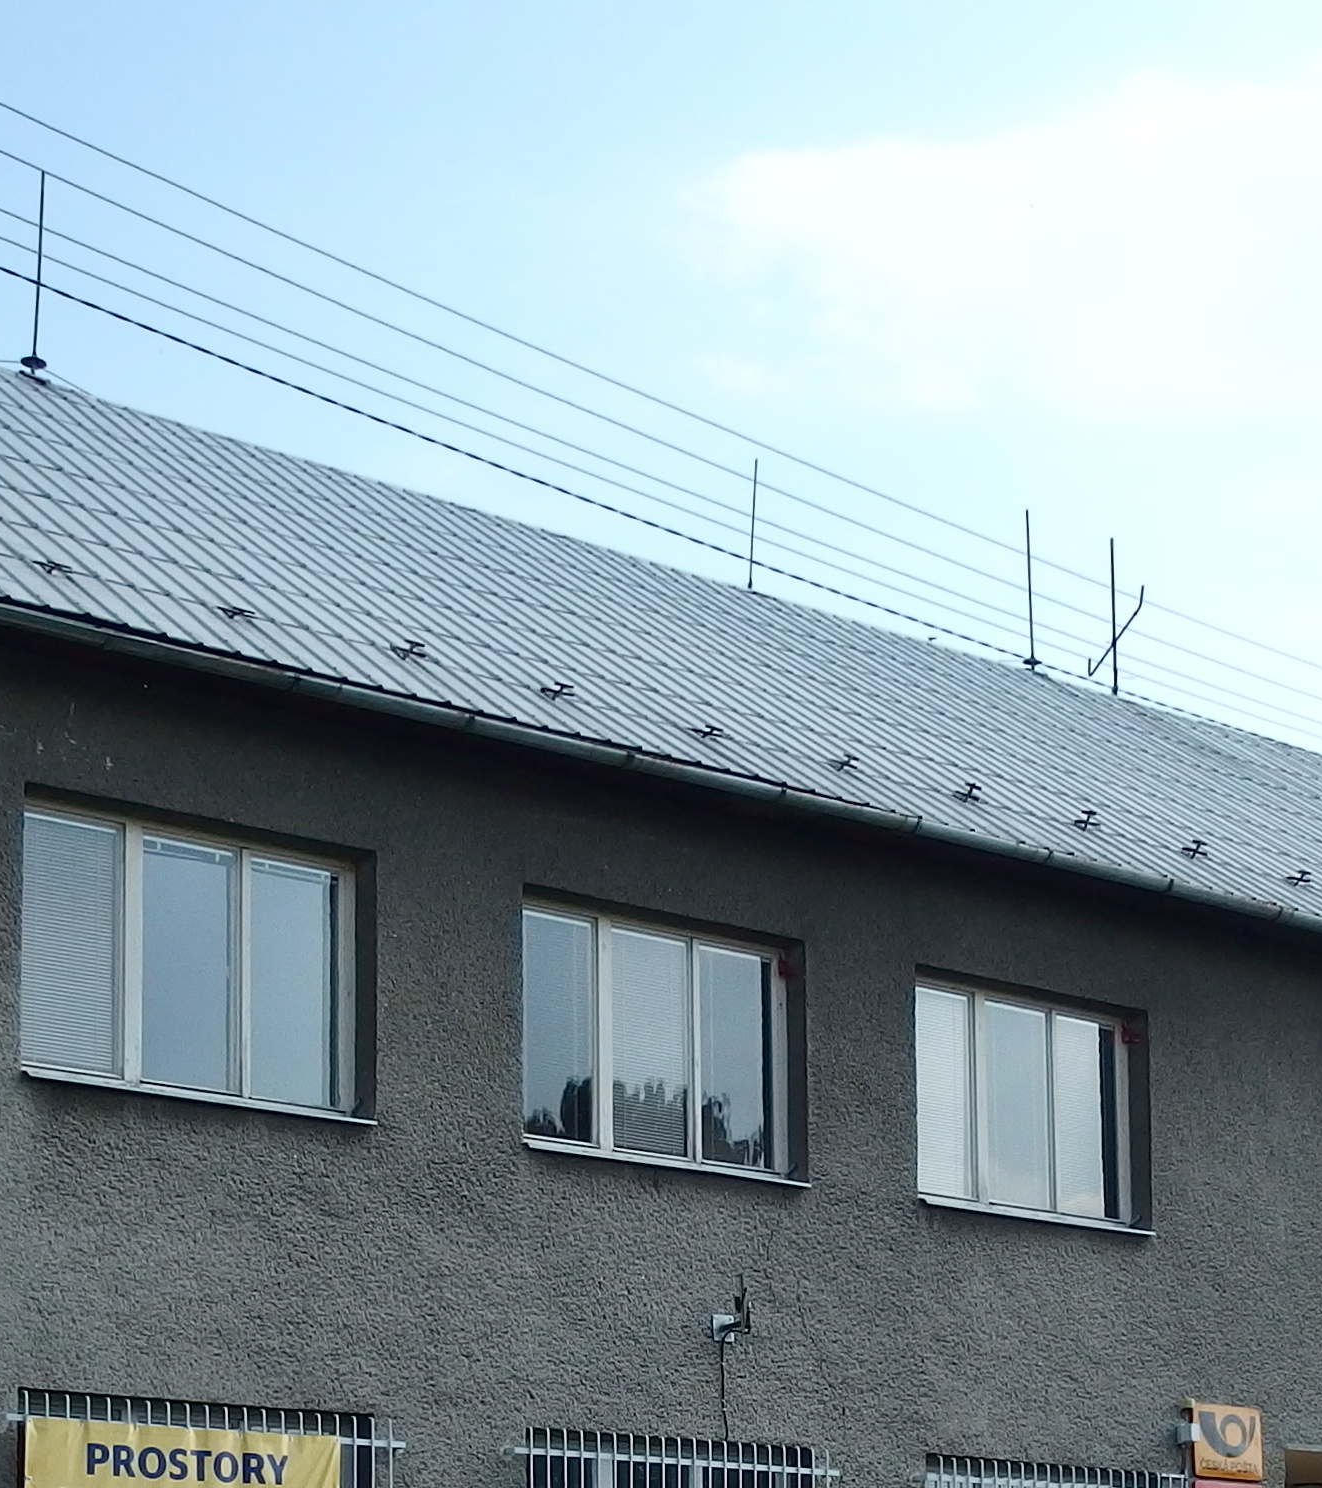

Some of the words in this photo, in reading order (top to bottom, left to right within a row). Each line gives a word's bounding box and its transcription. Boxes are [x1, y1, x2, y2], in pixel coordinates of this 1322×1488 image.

[86, 1443, 289, 1485] PROSTORY
[1199, 1457, 1228, 1470] ČESKÁ
[1230, 1461, 1259, 1474] POŠTA
